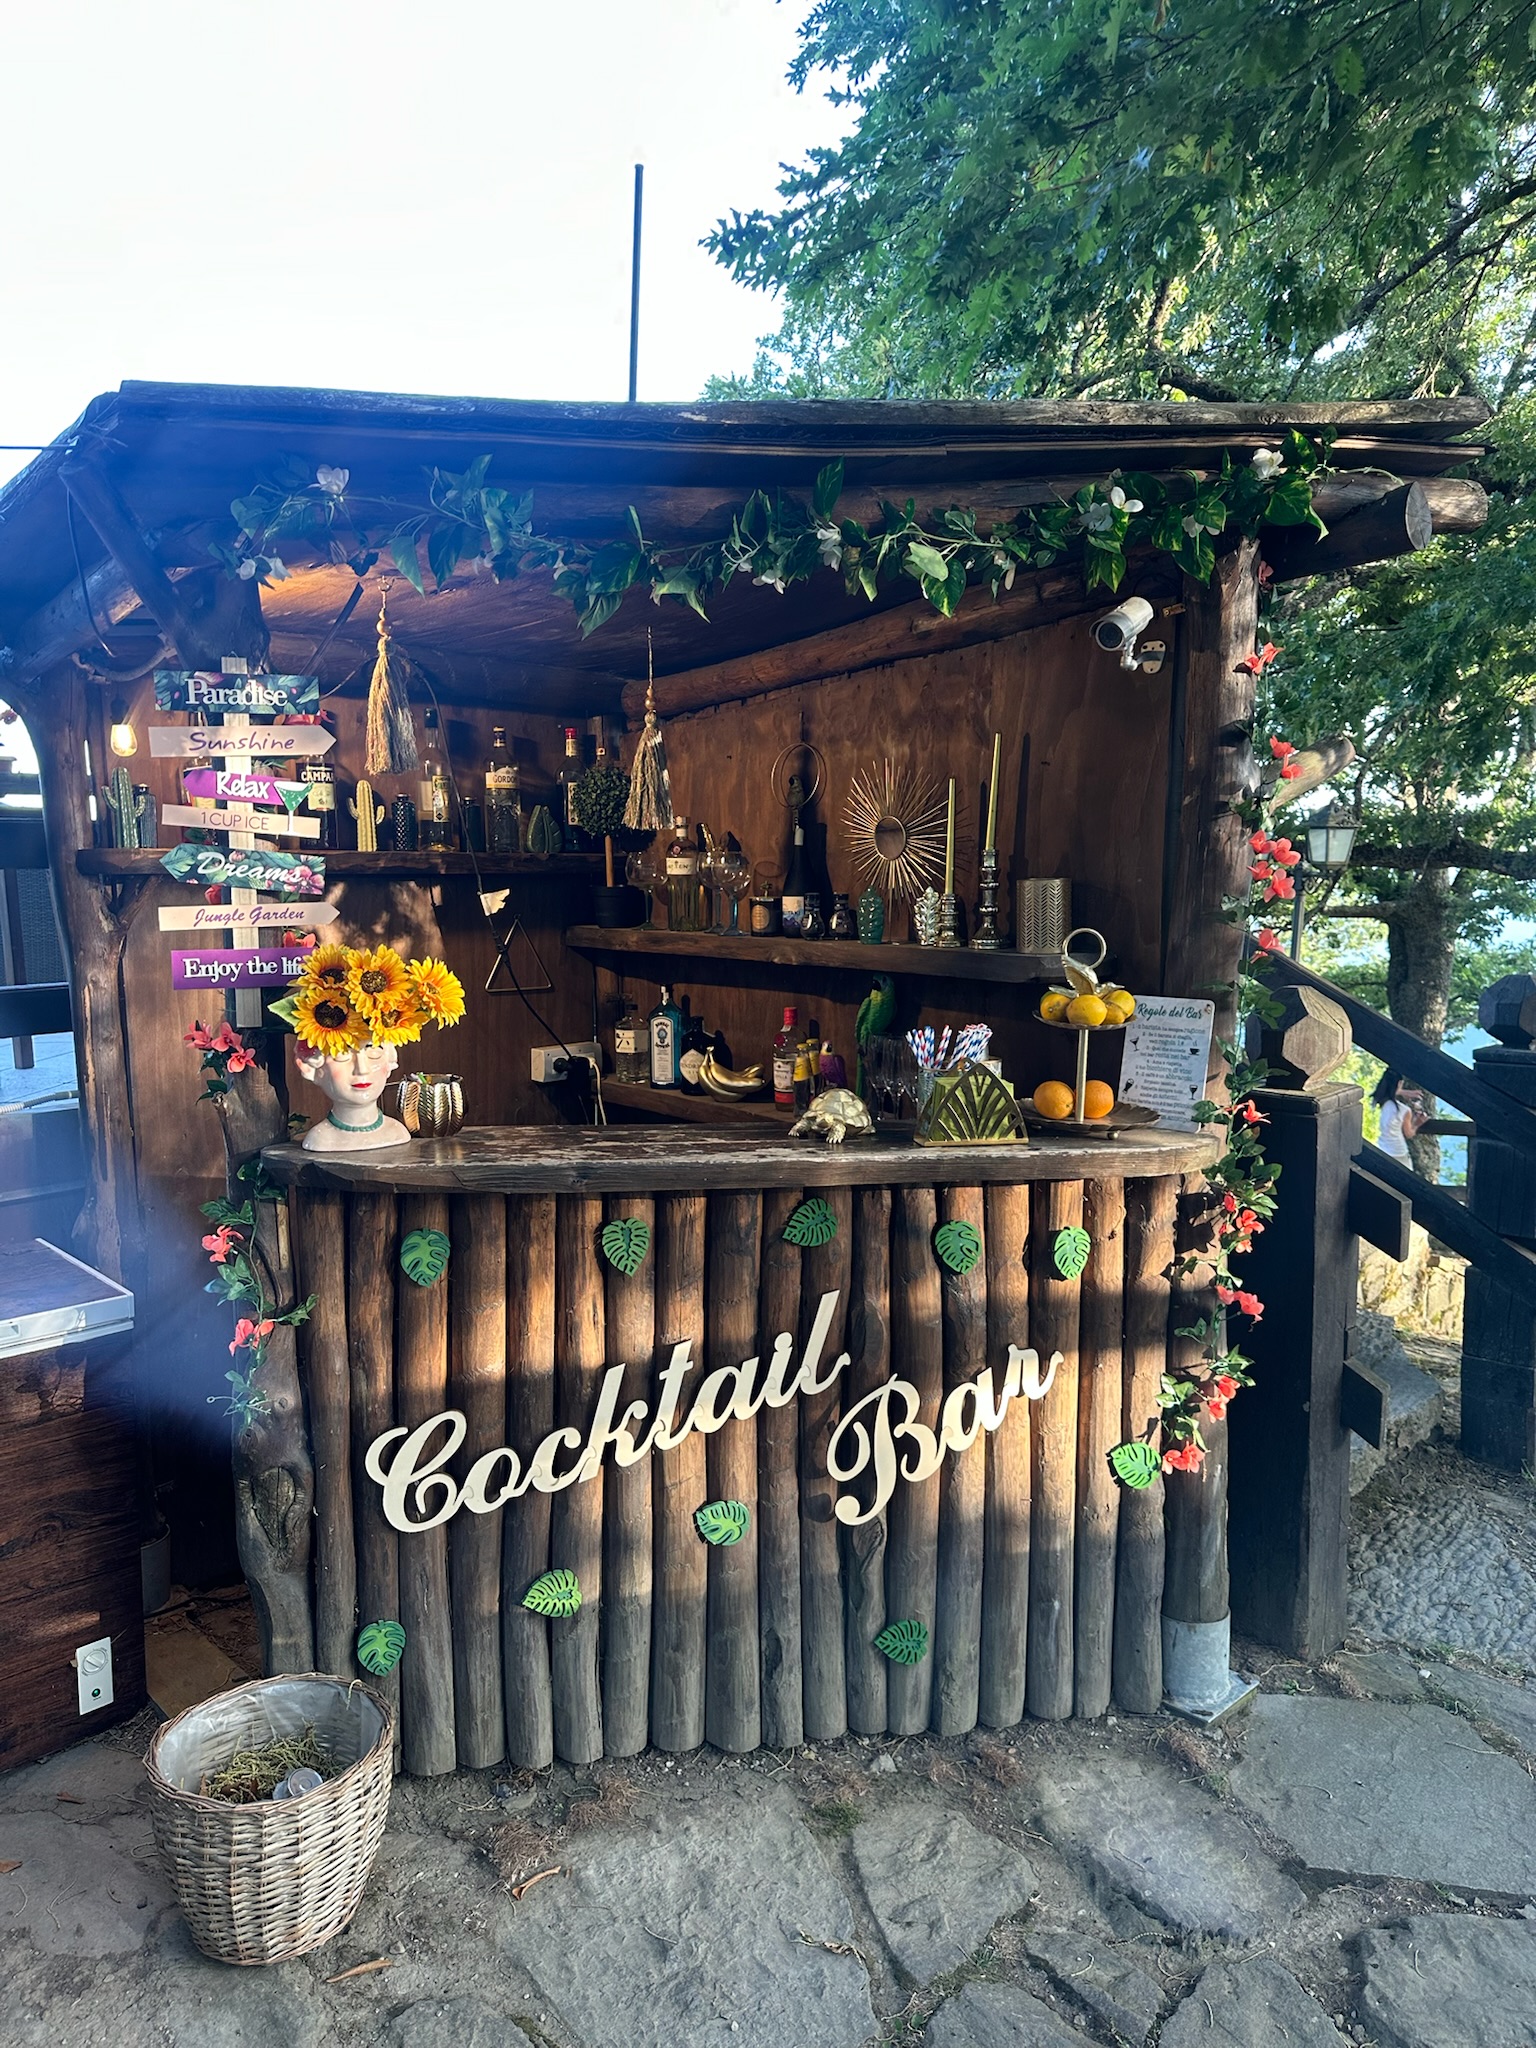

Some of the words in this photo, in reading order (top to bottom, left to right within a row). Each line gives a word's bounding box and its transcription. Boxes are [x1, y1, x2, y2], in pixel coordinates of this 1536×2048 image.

[185, 678, 288, 707] Paradise
[188, 731, 295, 752] Sunshine
[216, 771, 271, 800] Relax
[200, 812, 207, 825] 1
[209, 812, 242, 828] CUP
[245, 815, 270, 831] ICE
[196, 851, 304, 883] Dreams
[193, 904, 246, 927] Jungle
[249, 906, 305, 923] Garden
[183, 957, 243, 983] Enjoy
[246, 956, 278, 976] the
[1138, 1003, 1166, 1021] Regole
[1168, 1005, 1184, 1017] del
[1185, 1006, 1203, 1020] Bar
[365, 1289, 851, 1534] Cocktail
[827, 1344, 1064, 1527] Bar
